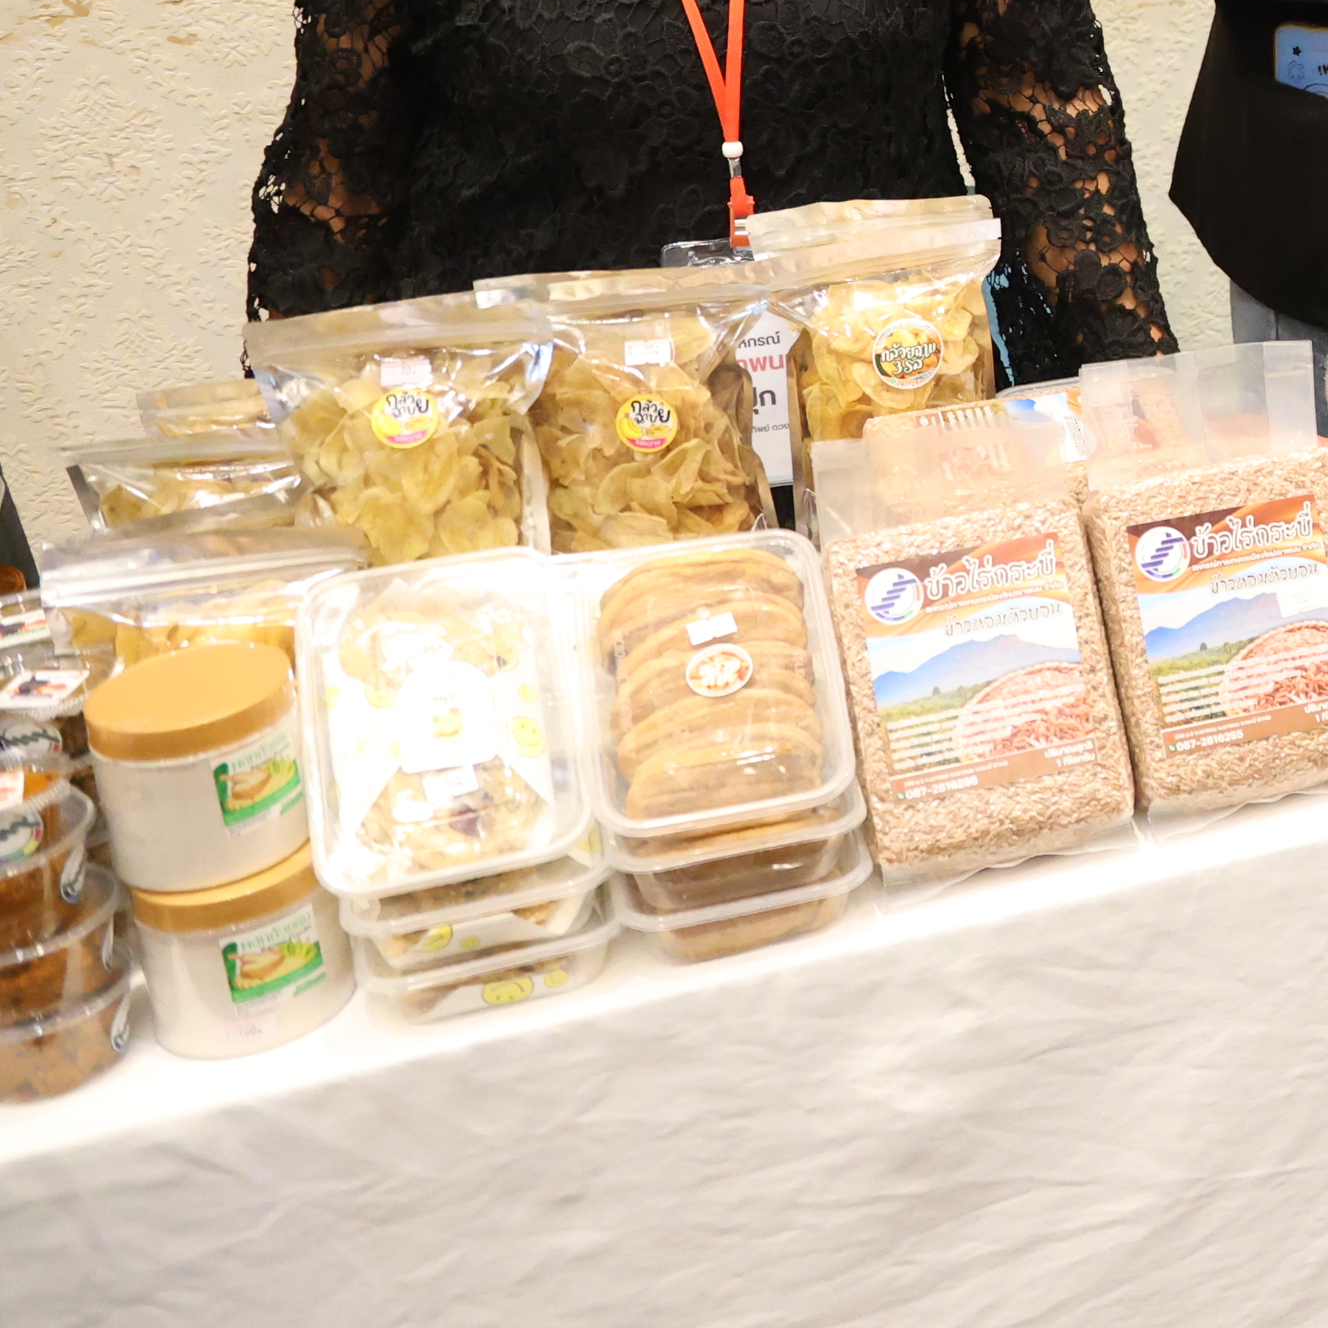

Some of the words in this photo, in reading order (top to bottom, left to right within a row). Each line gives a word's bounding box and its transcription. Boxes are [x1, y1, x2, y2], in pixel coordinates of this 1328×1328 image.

[881, 342, 938, 362] กล้วยฉาบ
[892, 360, 903, 375] 3
[903, 358, 924, 374] รส
[1192, 501, 1314, 559] ข้าวไร่กระบี่
[925, 538, 1057, 601] ข้าวไร่กระบี่
